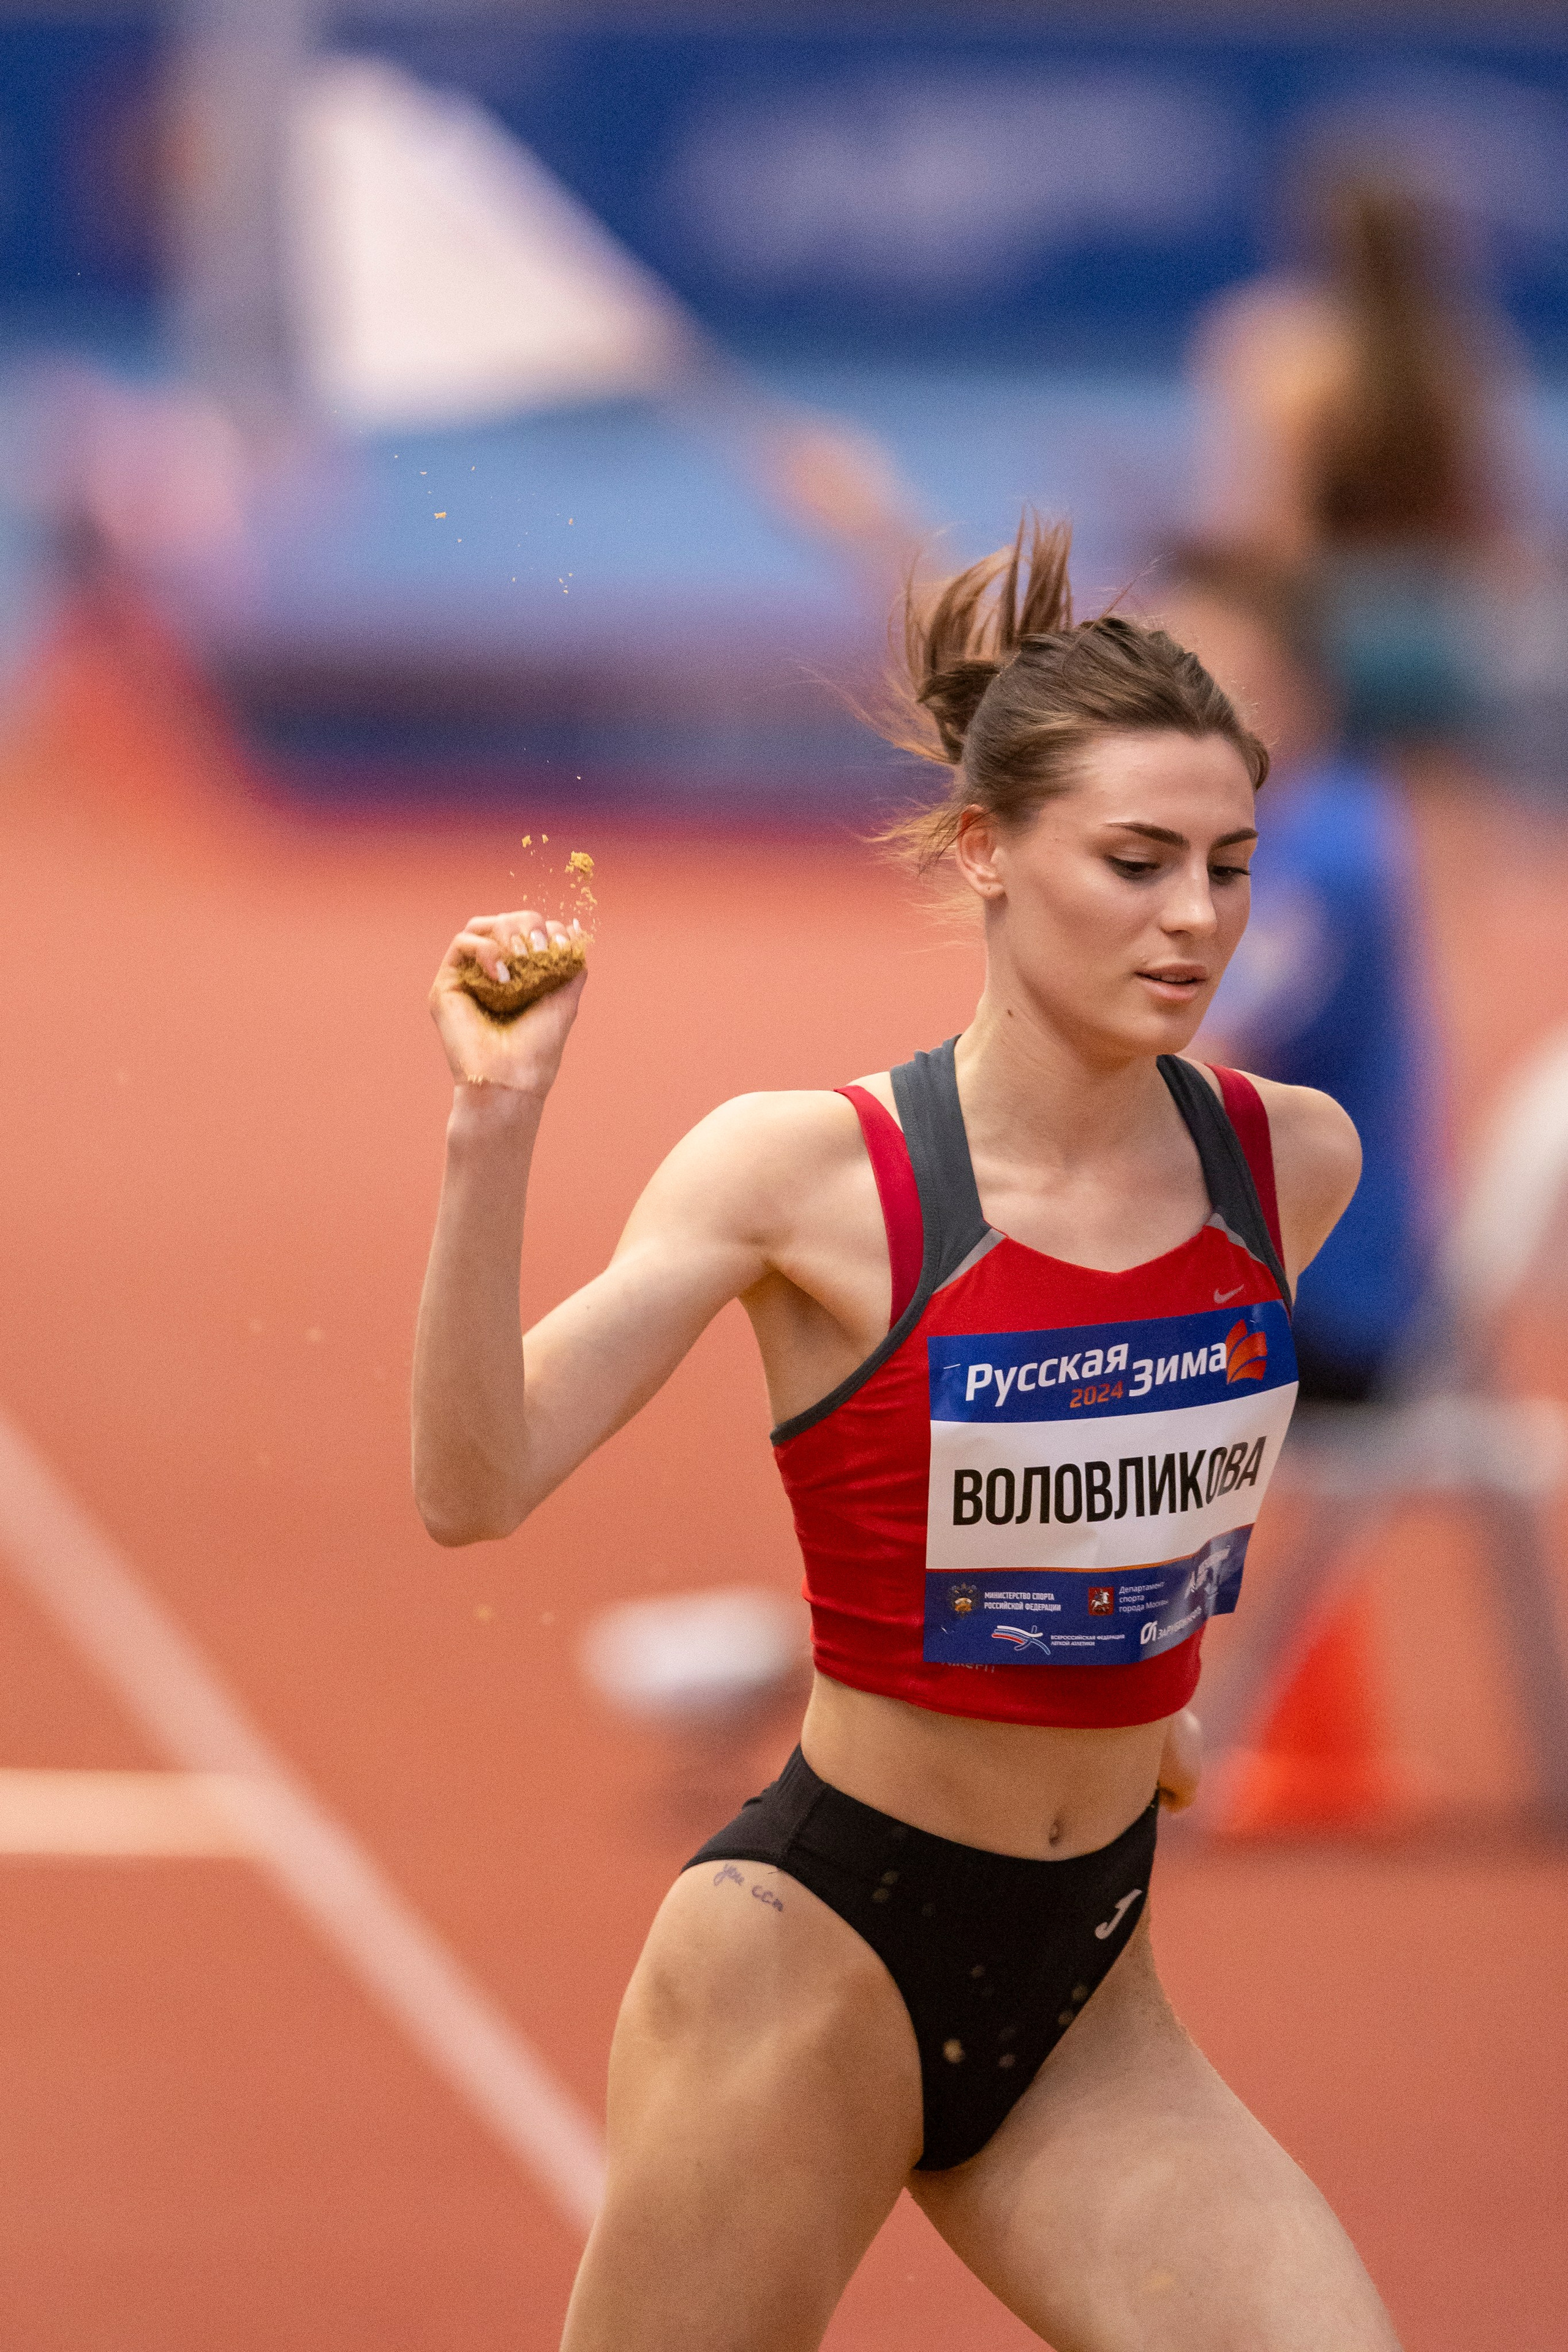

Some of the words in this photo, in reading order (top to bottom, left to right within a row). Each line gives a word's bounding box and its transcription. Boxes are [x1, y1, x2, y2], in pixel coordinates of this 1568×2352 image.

[965, 1343, 1129, 1407] Русская
[1128, 1342, 1227, 1397] Зима
[1069, 1380, 1124, 1408] 2024
[952, 1435, 1267, 1526] ВОЛОВЛИКОВА
[984, 1592, 1031, 1600] МИНИСТЕРСТВО
[1119, 1595, 1145, 1604] спорта
[984, 1601, 1024, 1610] РОССИЙСКОЙ
[1025, 1602, 1061, 1611] ФЕДЕРАЦИИ
[1118, 1604, 1145, 1613] города
